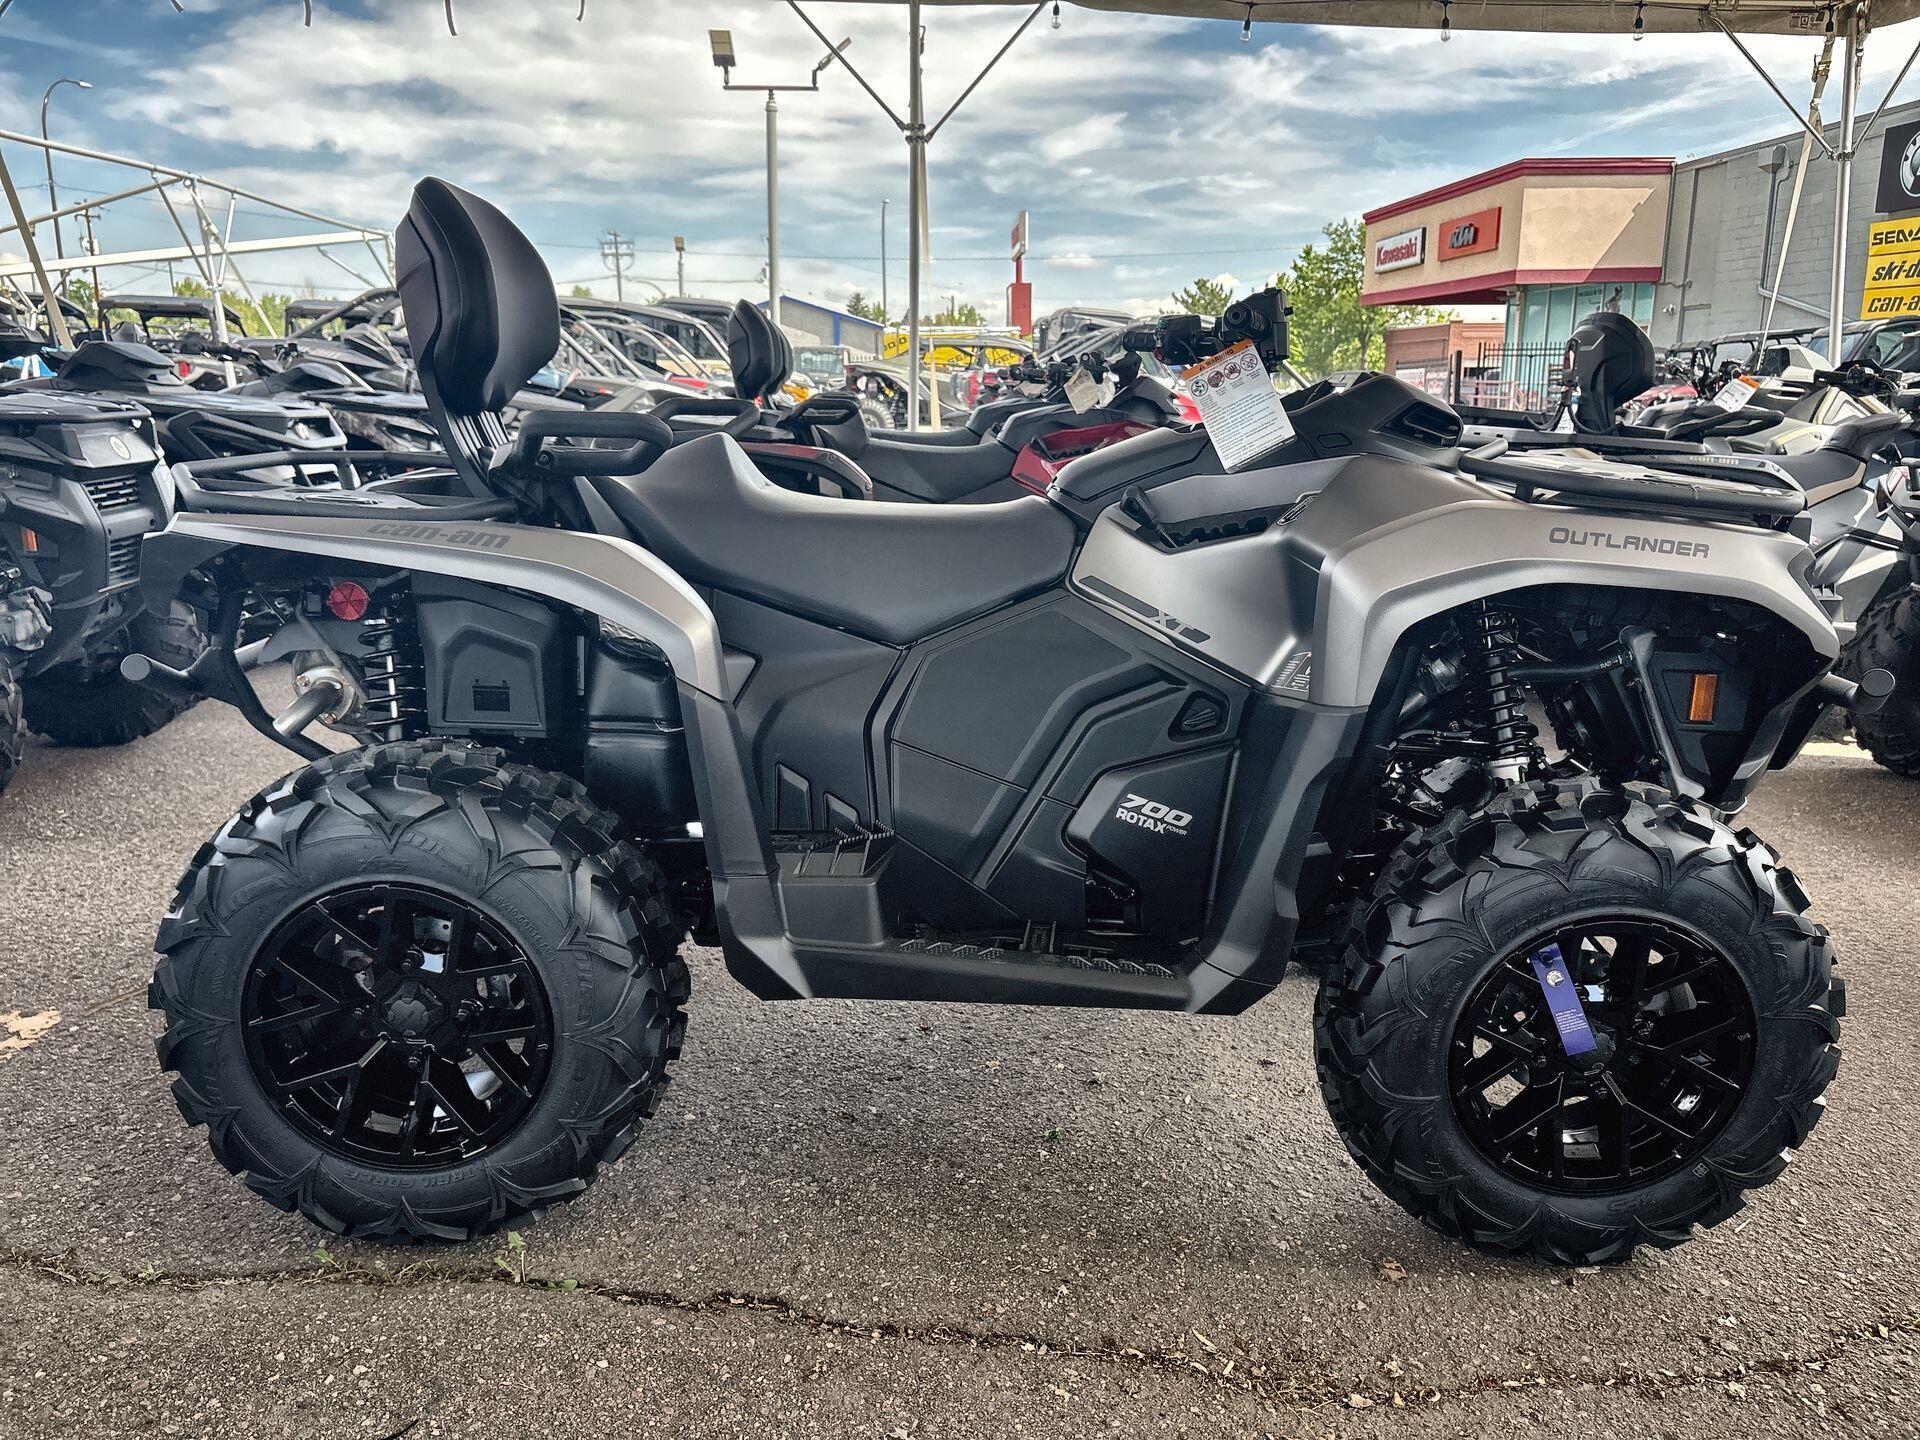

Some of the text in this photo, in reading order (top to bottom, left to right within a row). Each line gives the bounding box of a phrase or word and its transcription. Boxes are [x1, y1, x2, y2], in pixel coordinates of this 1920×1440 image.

[1449, 223, 1476, 249] KTM
[1376, 236, 1418, 267] Kawasaki
[1867, 295, 1920, 312] can-a
[1205, 348, 1235, 367] WARNING
[367, 523, 511, 548] can-am
[1549, 527, 1710, 559] OUTLANDER
[1148, 609, 1195, 634] XT
[1115, 807, 1188, 836] ROTAX POWER
[1120, 793, 1193, 827] 700
